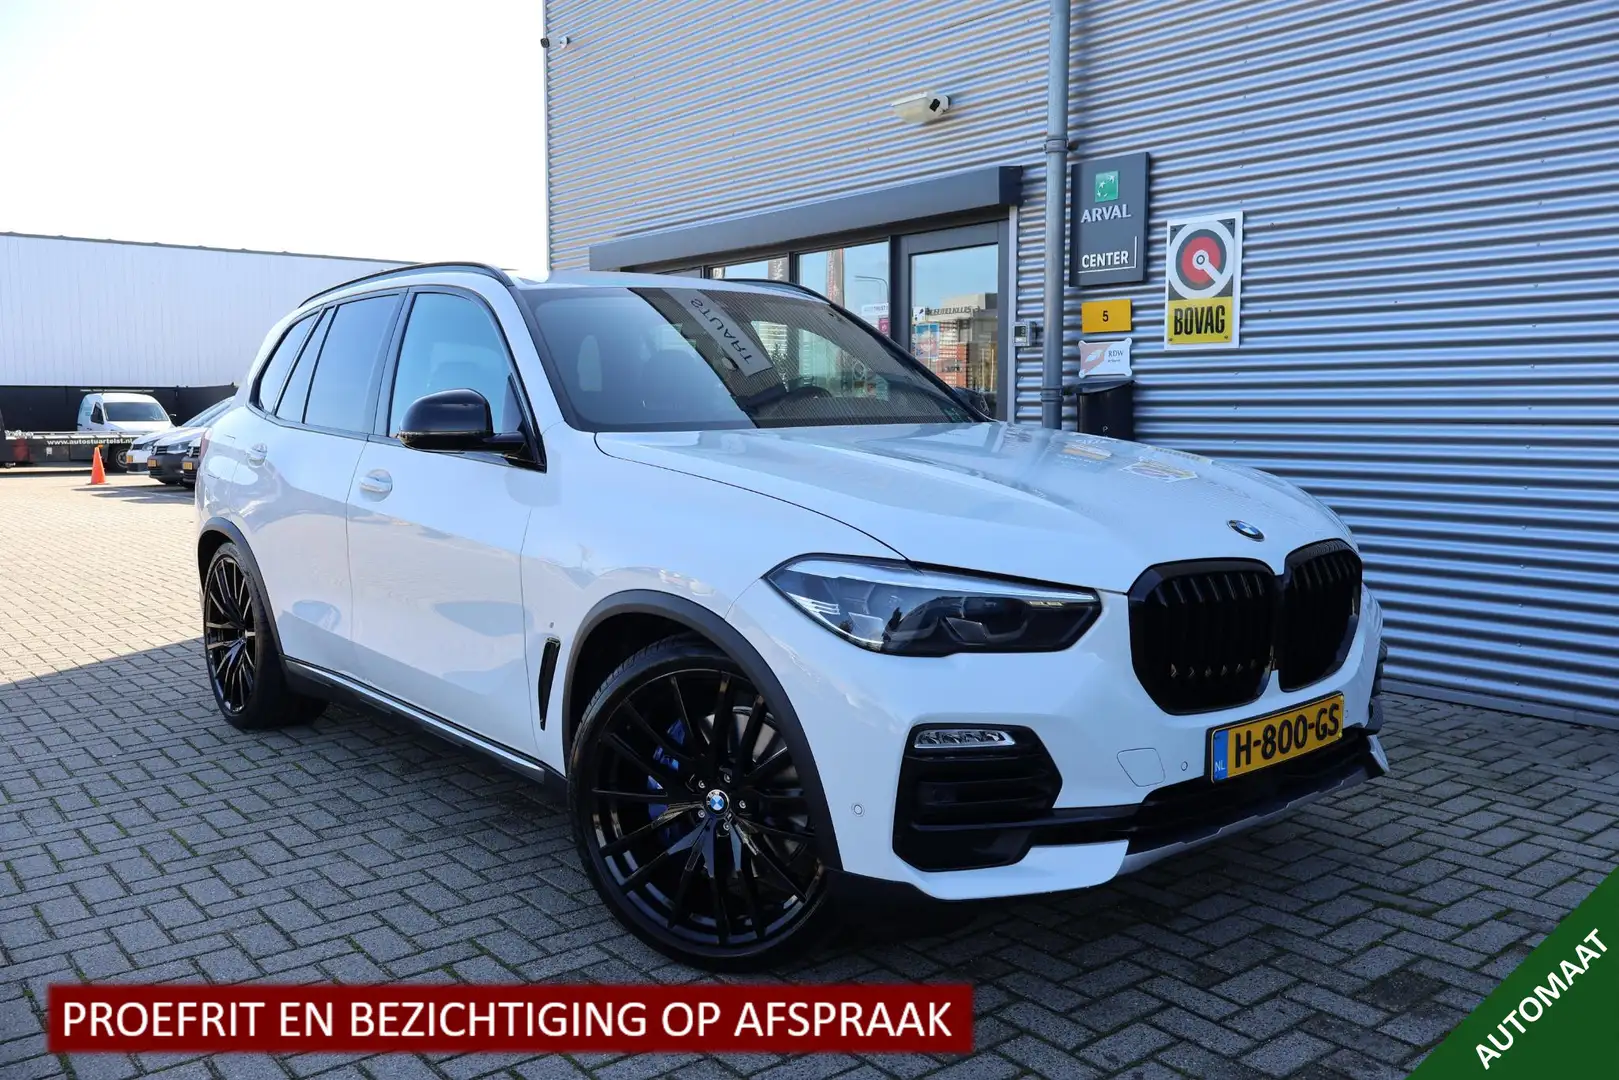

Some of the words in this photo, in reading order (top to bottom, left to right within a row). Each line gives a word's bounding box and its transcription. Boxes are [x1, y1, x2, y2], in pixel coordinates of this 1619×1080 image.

[1081, 204, 1131, 223] ARVAL
[1082, 251, 1128, 268] CENTER
[1102, 311, 1109, 322] 5
[1173, 304, 1225, 336] BOVAG
[1108, 349, 1124, 357] RDW
[1235, 703, 1339, 768] H-800-GS
[1214, 760, 1225, 771] NL
